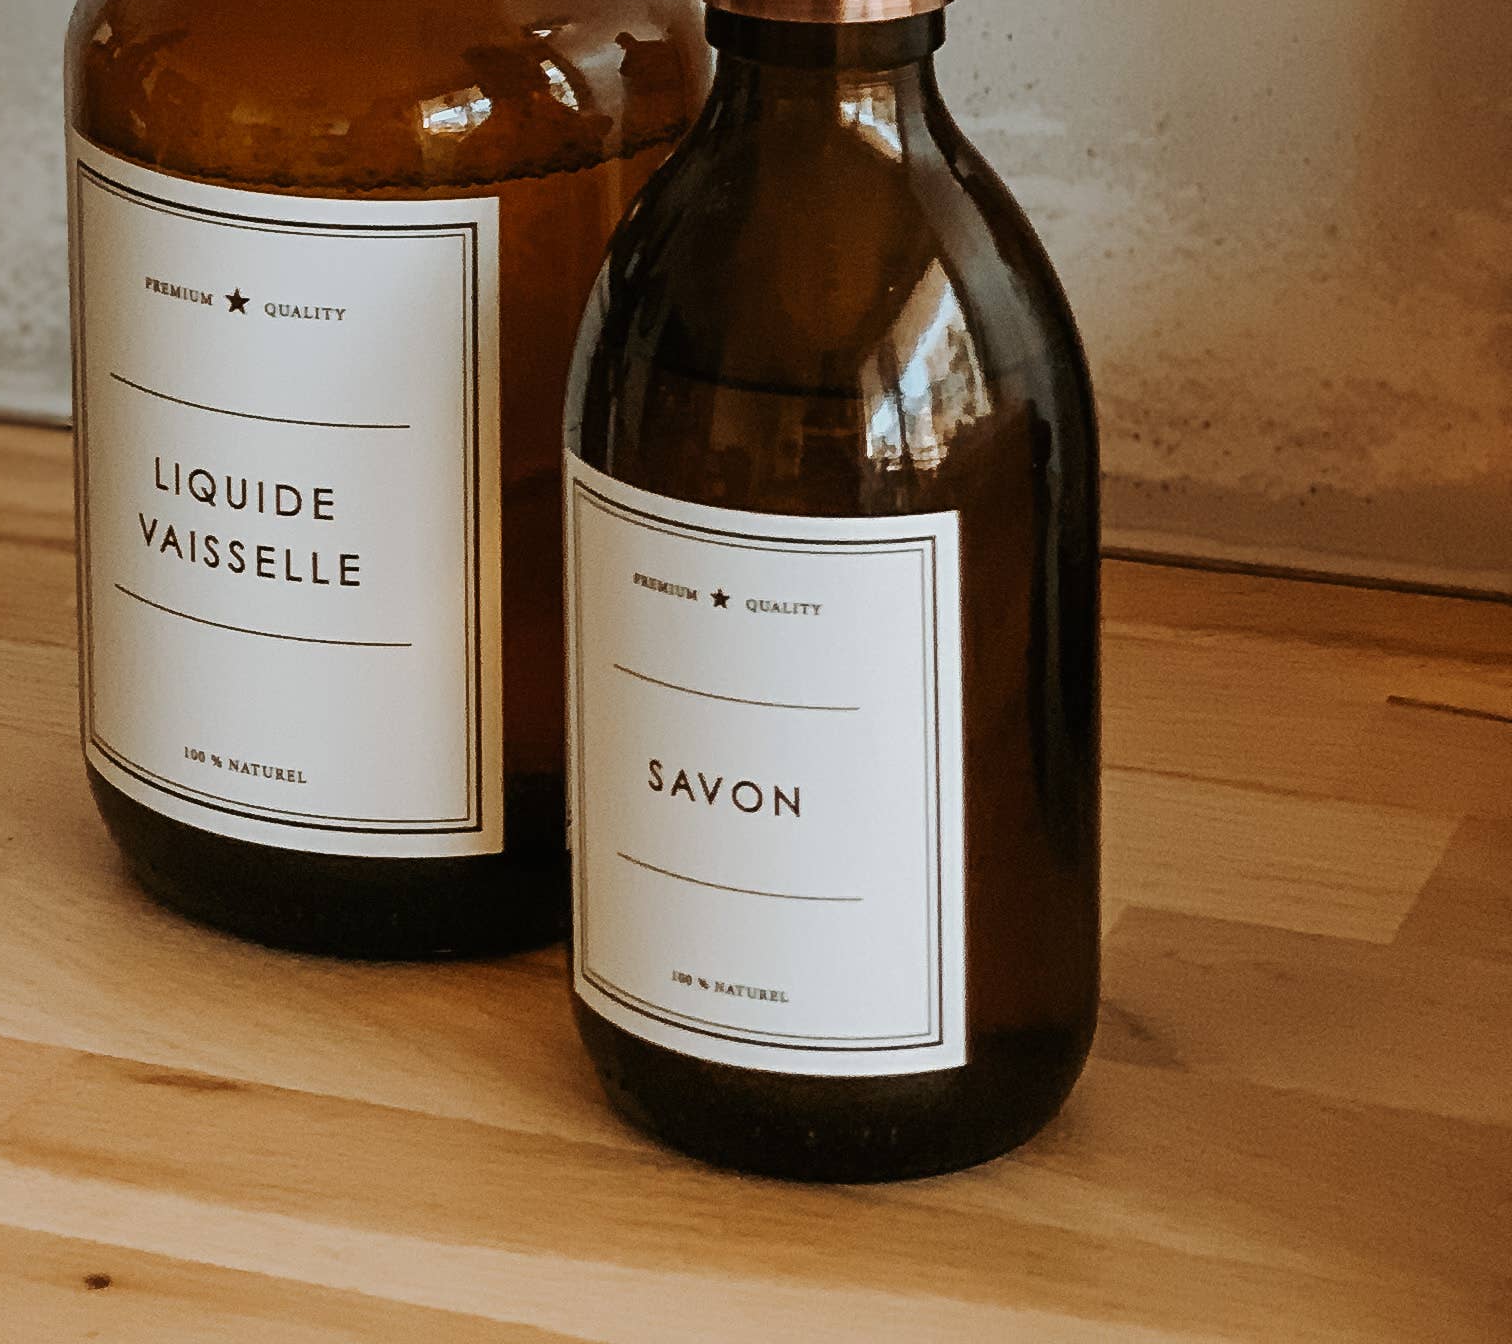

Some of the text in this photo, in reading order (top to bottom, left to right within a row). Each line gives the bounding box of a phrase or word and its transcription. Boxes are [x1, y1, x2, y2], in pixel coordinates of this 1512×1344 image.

[145, 276, 347, 321] PREMIUM QUALITY
[154, 456, 335, 522] LIQUIDE
[138, 512, 361, 587] VAISSELLE
[633, 572, 823, 615] PREMIUM QUALITY
[184, 746, 307, 783] 100 % NATUREL
[648, 758, 803, 818] SAVON
[714, 980, 788, 1003] NATUREL
